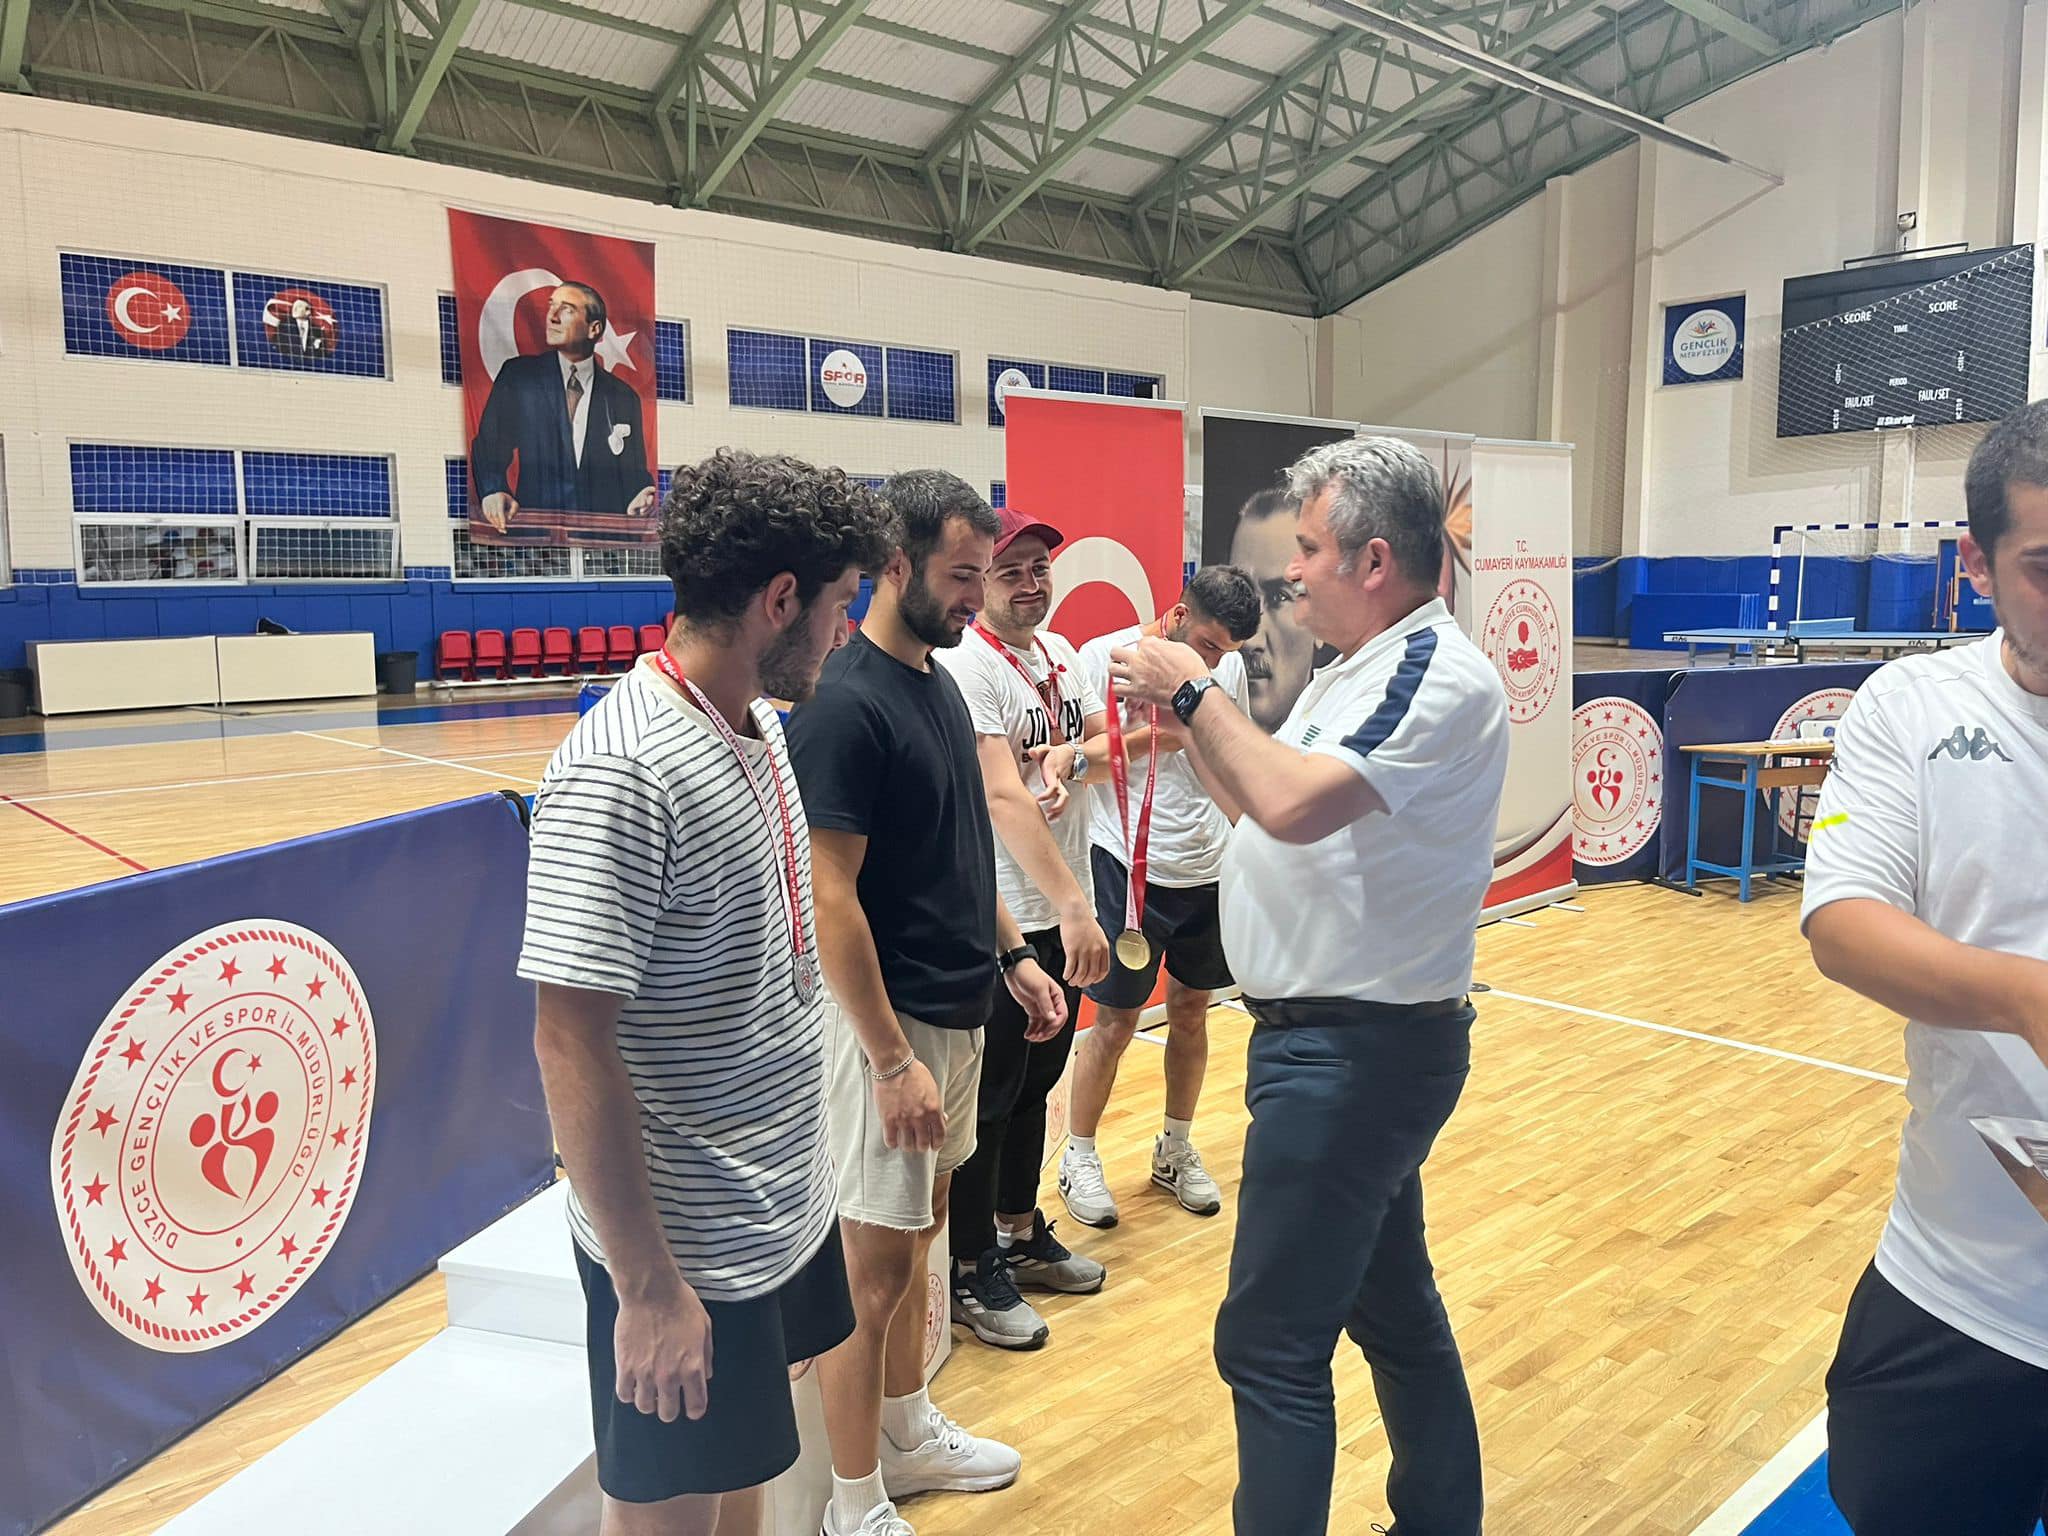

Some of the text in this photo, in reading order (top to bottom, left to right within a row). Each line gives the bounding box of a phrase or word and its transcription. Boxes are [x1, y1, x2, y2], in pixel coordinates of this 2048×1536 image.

[1928, 300, 1958, 314] SCORE
[1843, 311, 1872, 325] SCORE
[1893, 324, 1909, 333] TIME
[1844, 395, 1875, 409] FAUL/SET
[1918, 388, 1950, 402] FAUL/SET
[1604, 732, 1624, 744] SPOR
[130, 1006, 324, 1249] DÜZCE GENÇLİK VE SPOR İL MÜDÜRLÜĞÜ
